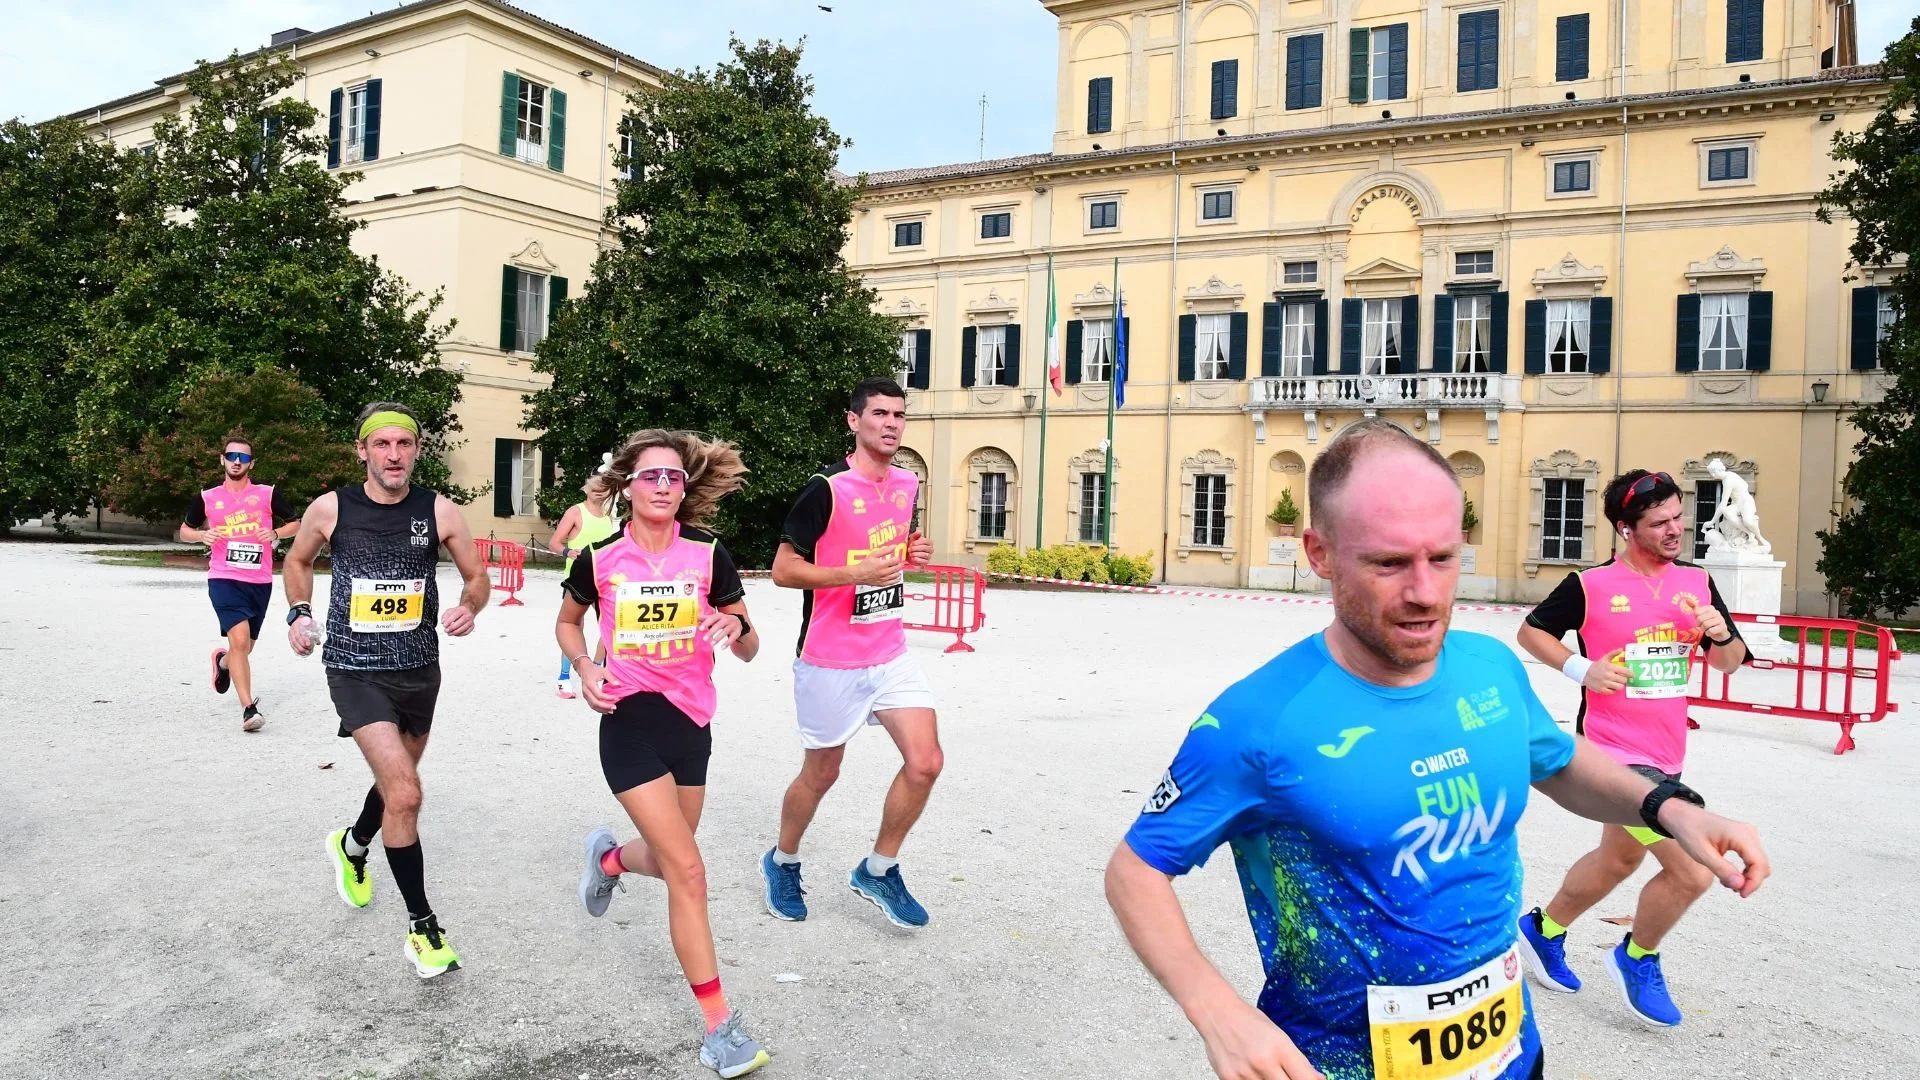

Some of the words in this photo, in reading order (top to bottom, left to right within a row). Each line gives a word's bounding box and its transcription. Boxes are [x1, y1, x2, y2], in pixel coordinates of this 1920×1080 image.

[1351, 188, 1421, 222] CARABINIERI
[410, 536, 429, 546] OTSO
[231, 551, 258, 561] 3377
[370, 598, 408, 615] 498
[862, 587, 895, 610] 3207
[637, 603, 679, 622] 257
[1637, 630, 1678, 644] RUN!
[1639, 662, 1682, 681] 2022
[1416, 772, 1481, 817] FUN
[1389, 786, 1508, 888] RUN
[1408, 998, 1507, 1066] 1086
